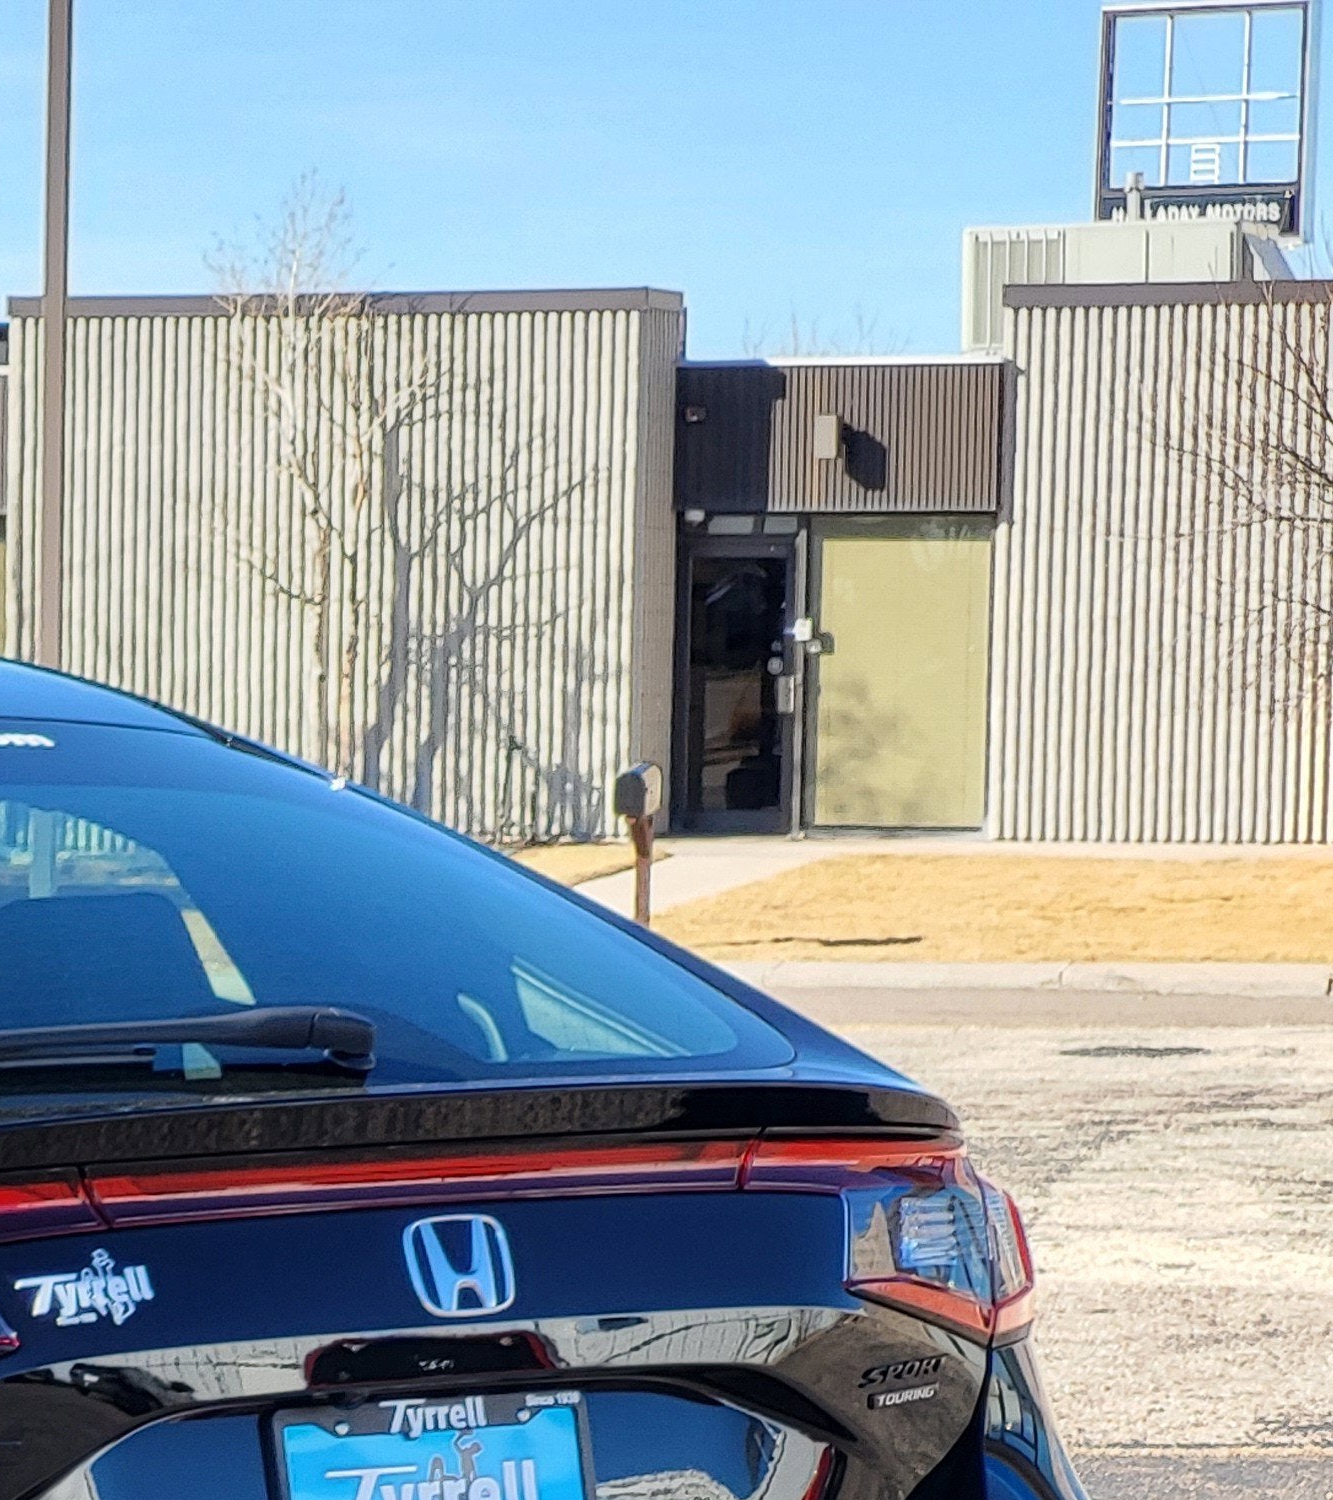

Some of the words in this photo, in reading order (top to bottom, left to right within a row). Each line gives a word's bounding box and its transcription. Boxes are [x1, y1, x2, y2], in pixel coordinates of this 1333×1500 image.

[1205, 201, 1282, 222] MOTORS
[13, 1264, 155, 1317] Tyrrell
[858, 1353, 949, 1388] SPORT
[877, 1385, 937, 1408] TOURING
[378, 1396, 488, 1438] Tyrrell
